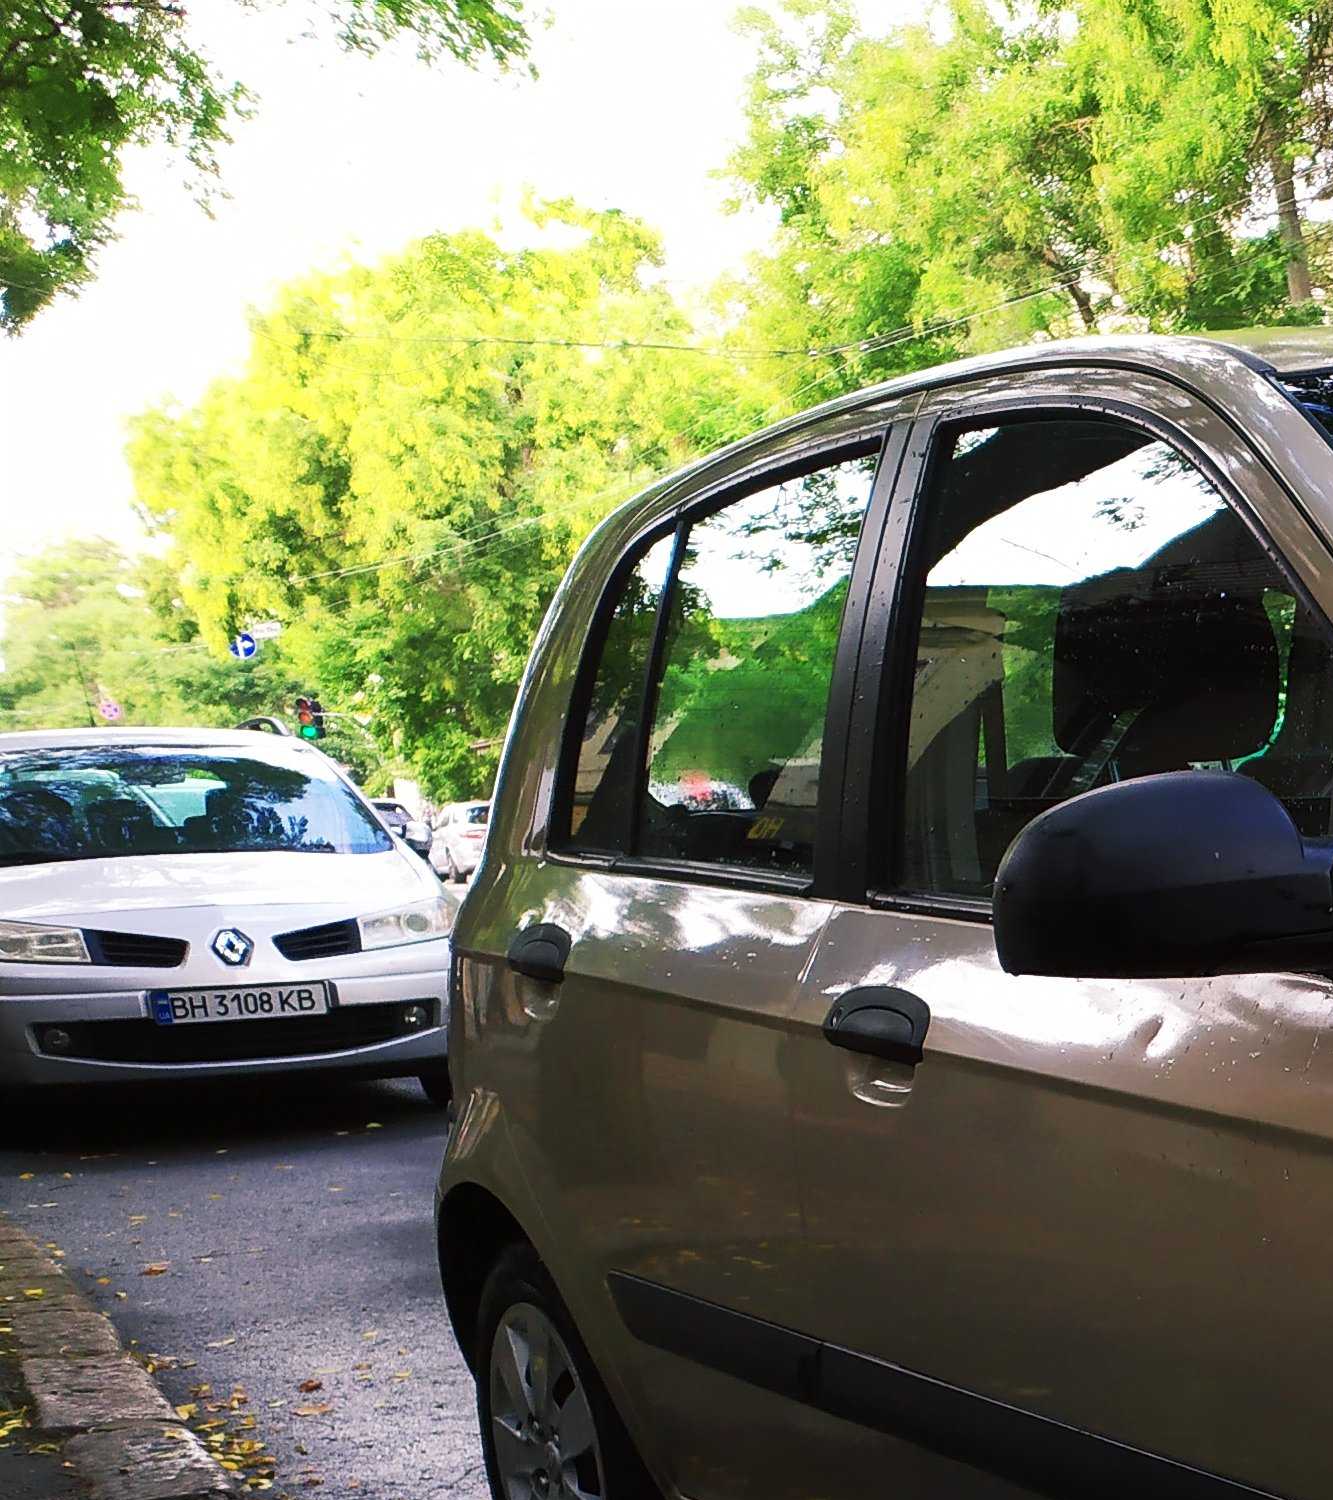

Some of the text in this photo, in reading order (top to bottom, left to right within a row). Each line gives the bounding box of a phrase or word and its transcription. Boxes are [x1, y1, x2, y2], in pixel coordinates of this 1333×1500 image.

[171, 988, 316, 1019] BH 3108 KB
